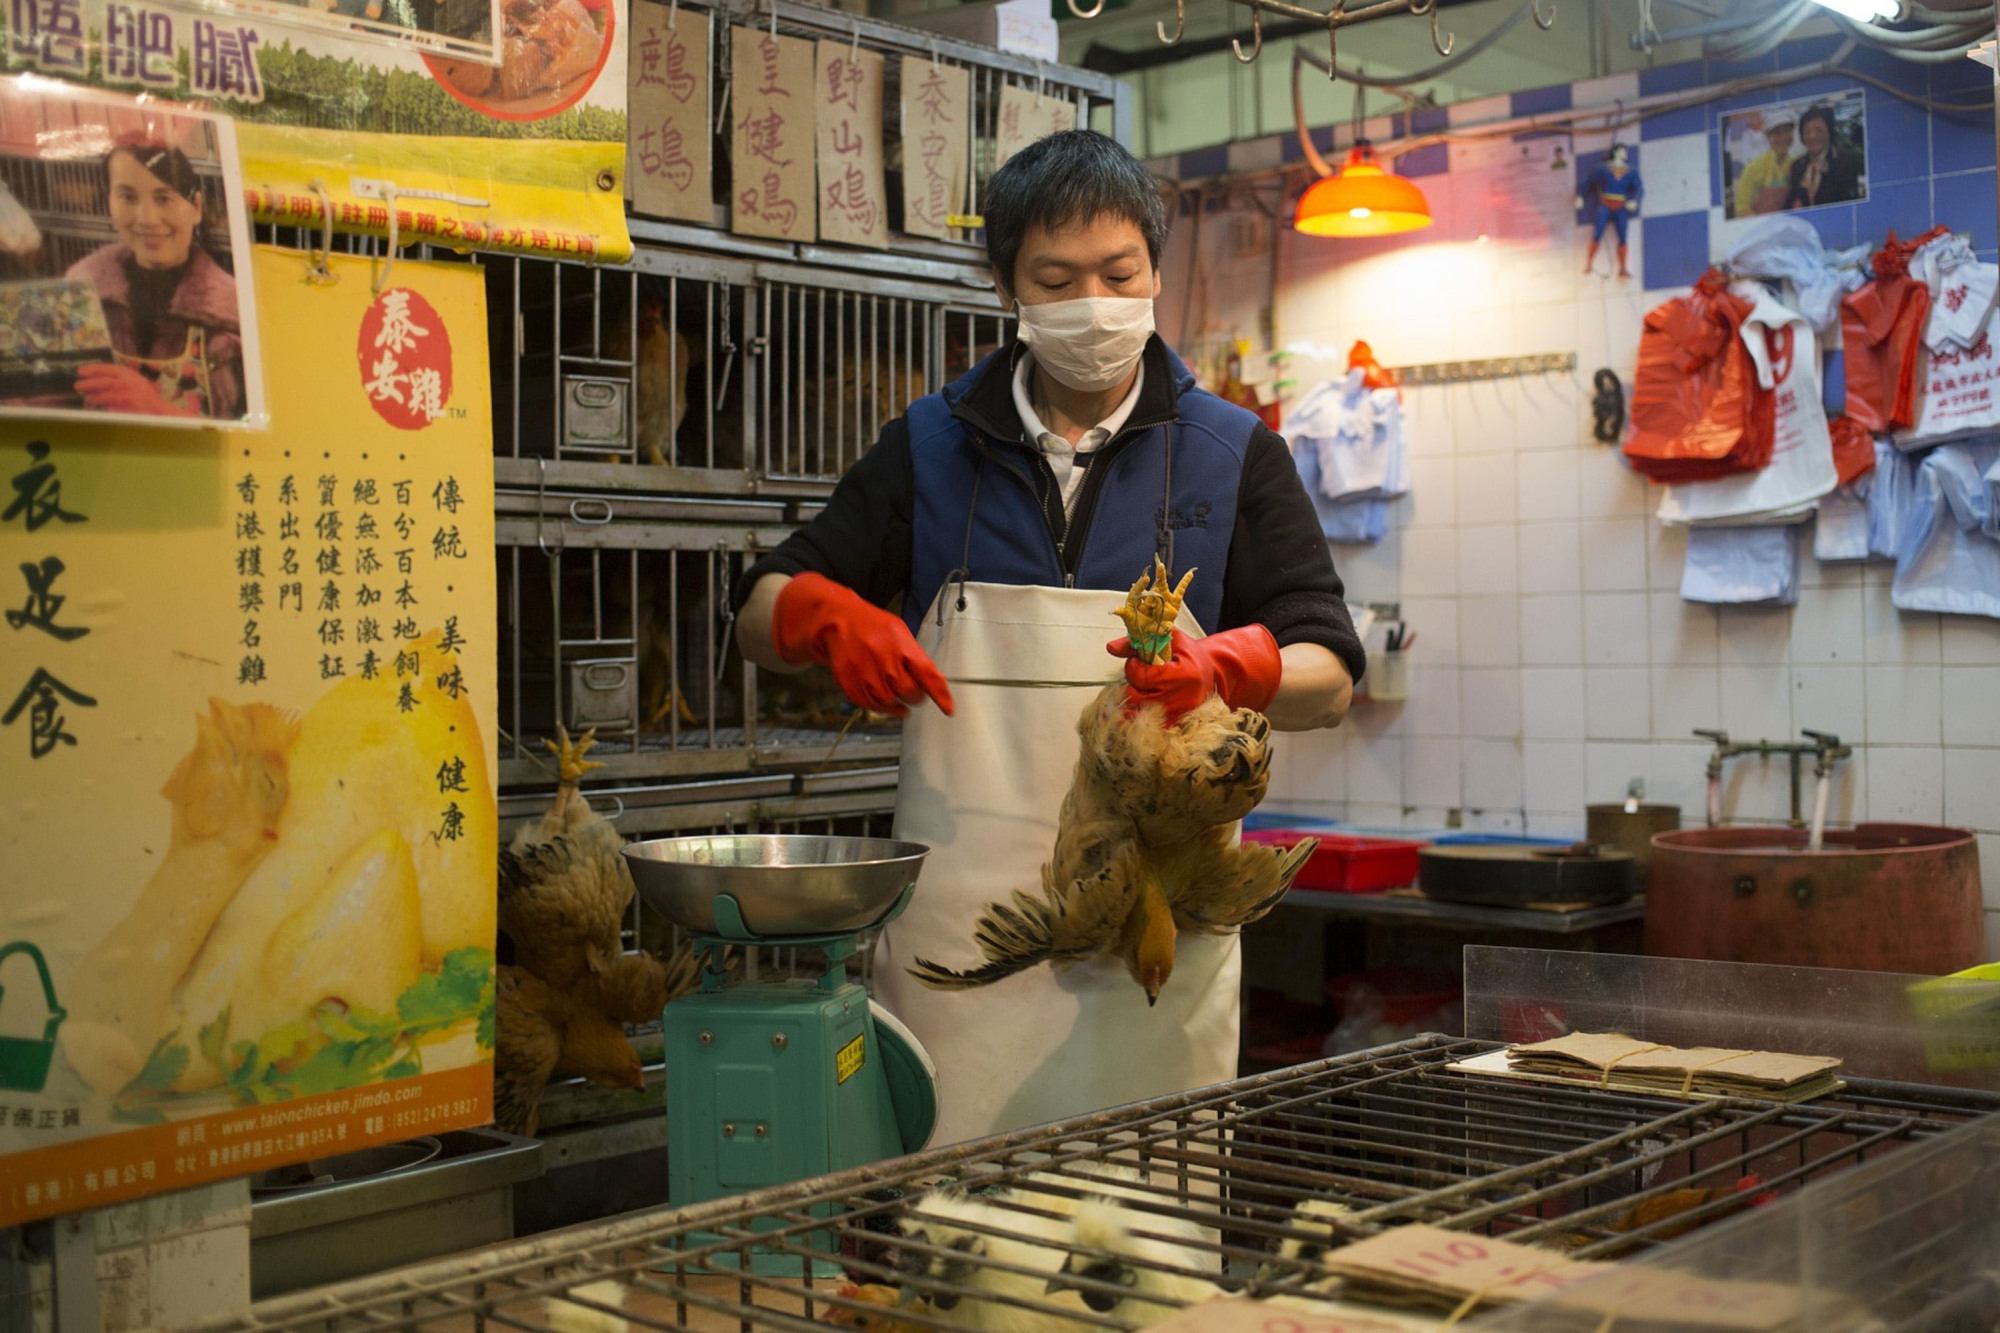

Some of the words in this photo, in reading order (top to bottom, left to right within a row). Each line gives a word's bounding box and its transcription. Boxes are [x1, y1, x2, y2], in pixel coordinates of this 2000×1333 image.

[448, 407, 467, 419] TM
[279, 474, 303, 612] 系出名門
